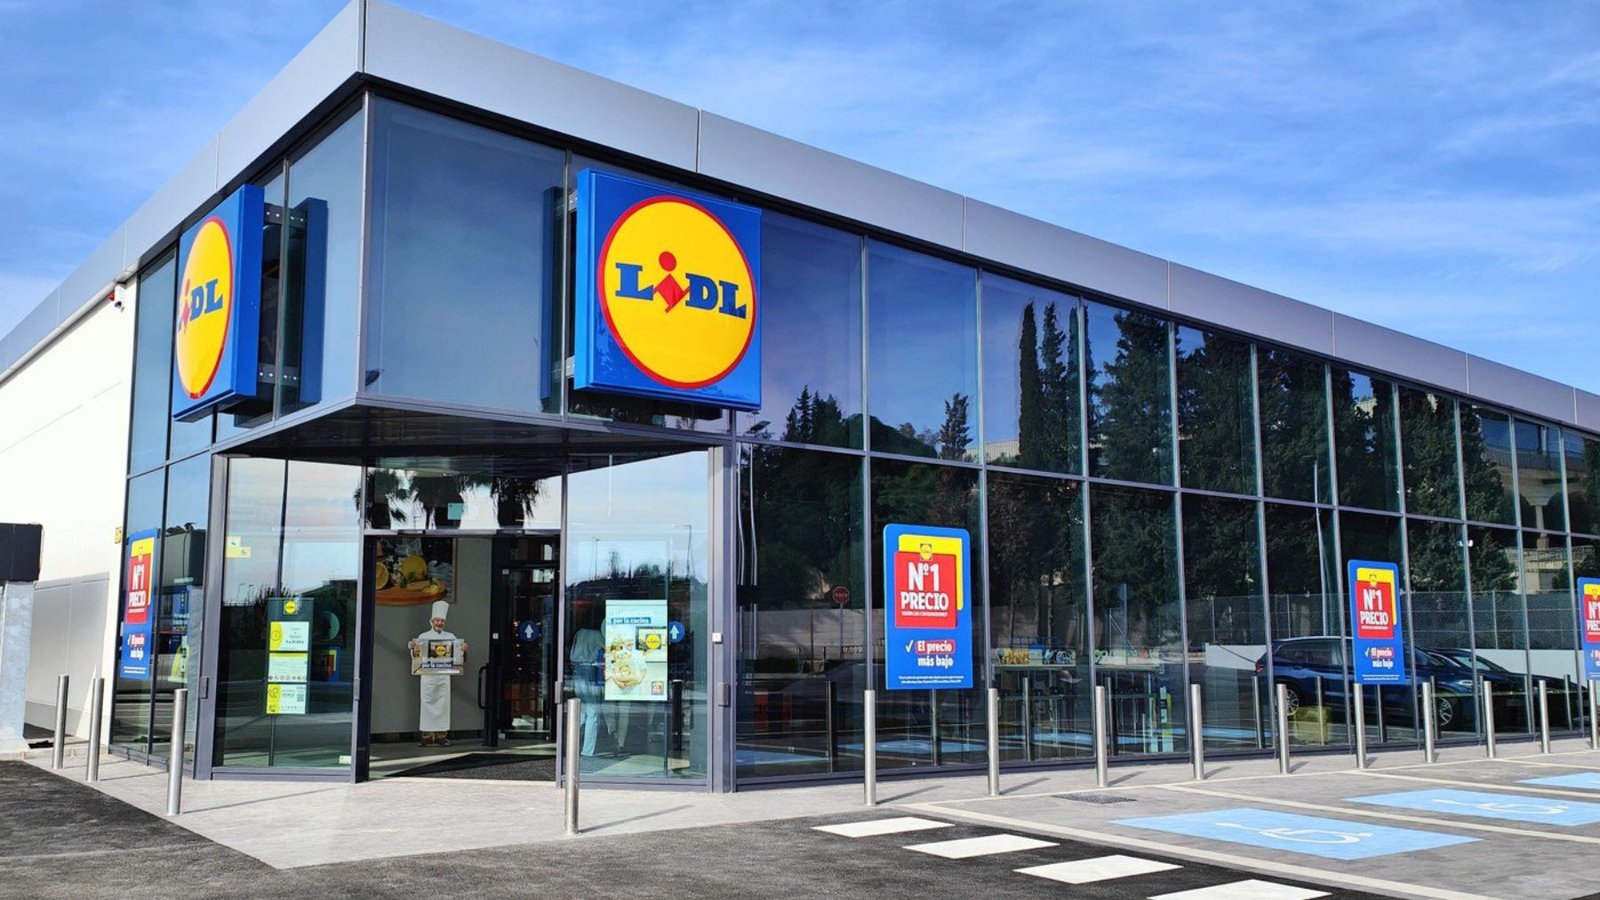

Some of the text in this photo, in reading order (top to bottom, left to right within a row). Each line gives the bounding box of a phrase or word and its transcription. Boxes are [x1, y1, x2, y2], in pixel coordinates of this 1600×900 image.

[615, 251, 747, 319] LIDL
[900, 591, 949, 610] PRECIO
[1360, 611, 1389, 625] PRECIO
[917, 640, 953, 656] El precio
[917, 654, 954, 669] más bajo
